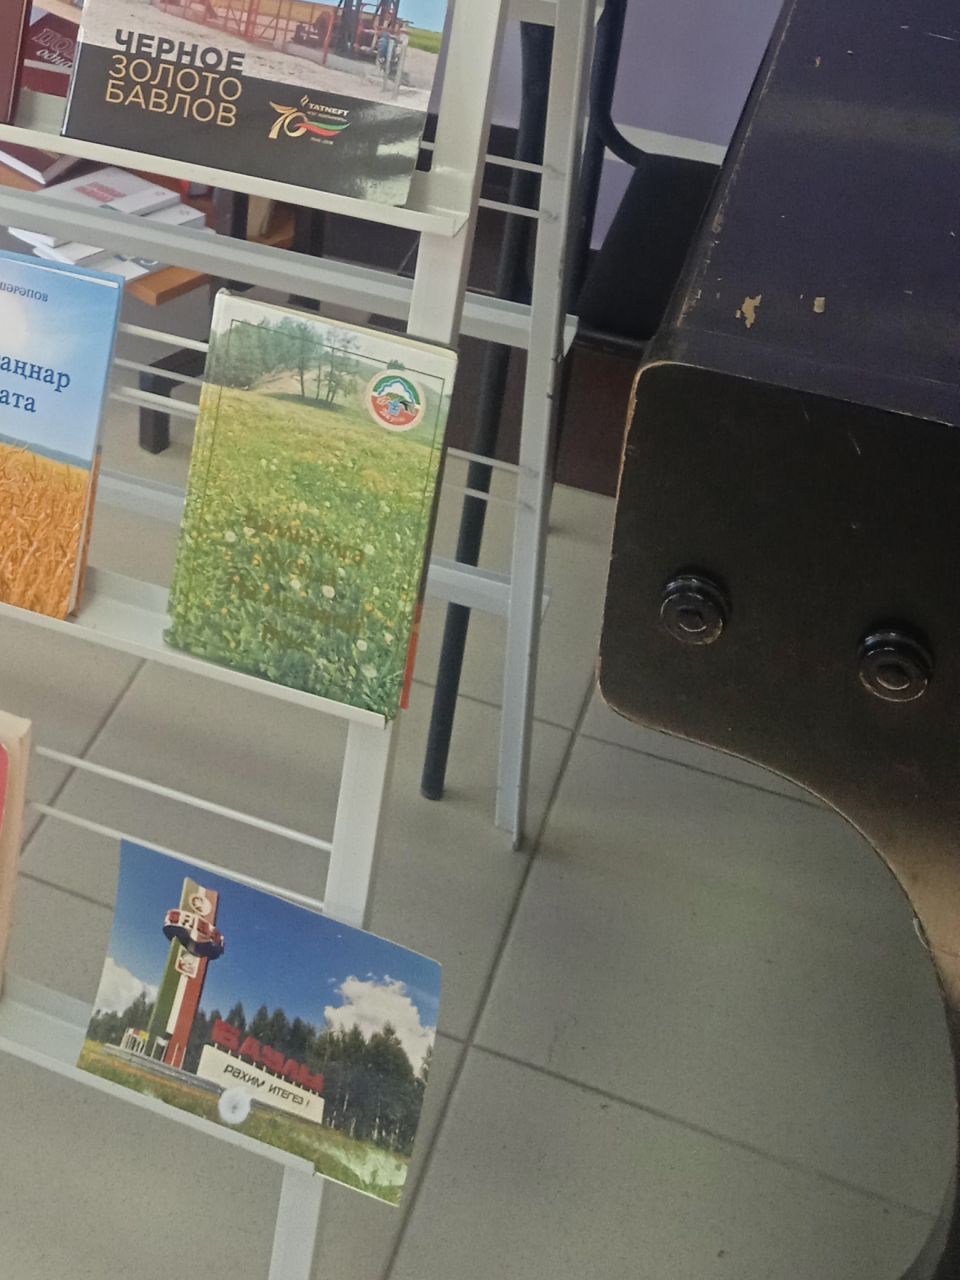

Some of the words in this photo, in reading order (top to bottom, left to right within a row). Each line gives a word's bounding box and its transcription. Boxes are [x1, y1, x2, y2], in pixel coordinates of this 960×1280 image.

[115, 28, 246, 73] ЧЕРНОЕ
[109, 54, 243, 101] ЗОЛОТО
[105, 79, 237, 127] БАВЛОВ
[308, 103, 350, 117] TATNEFT
